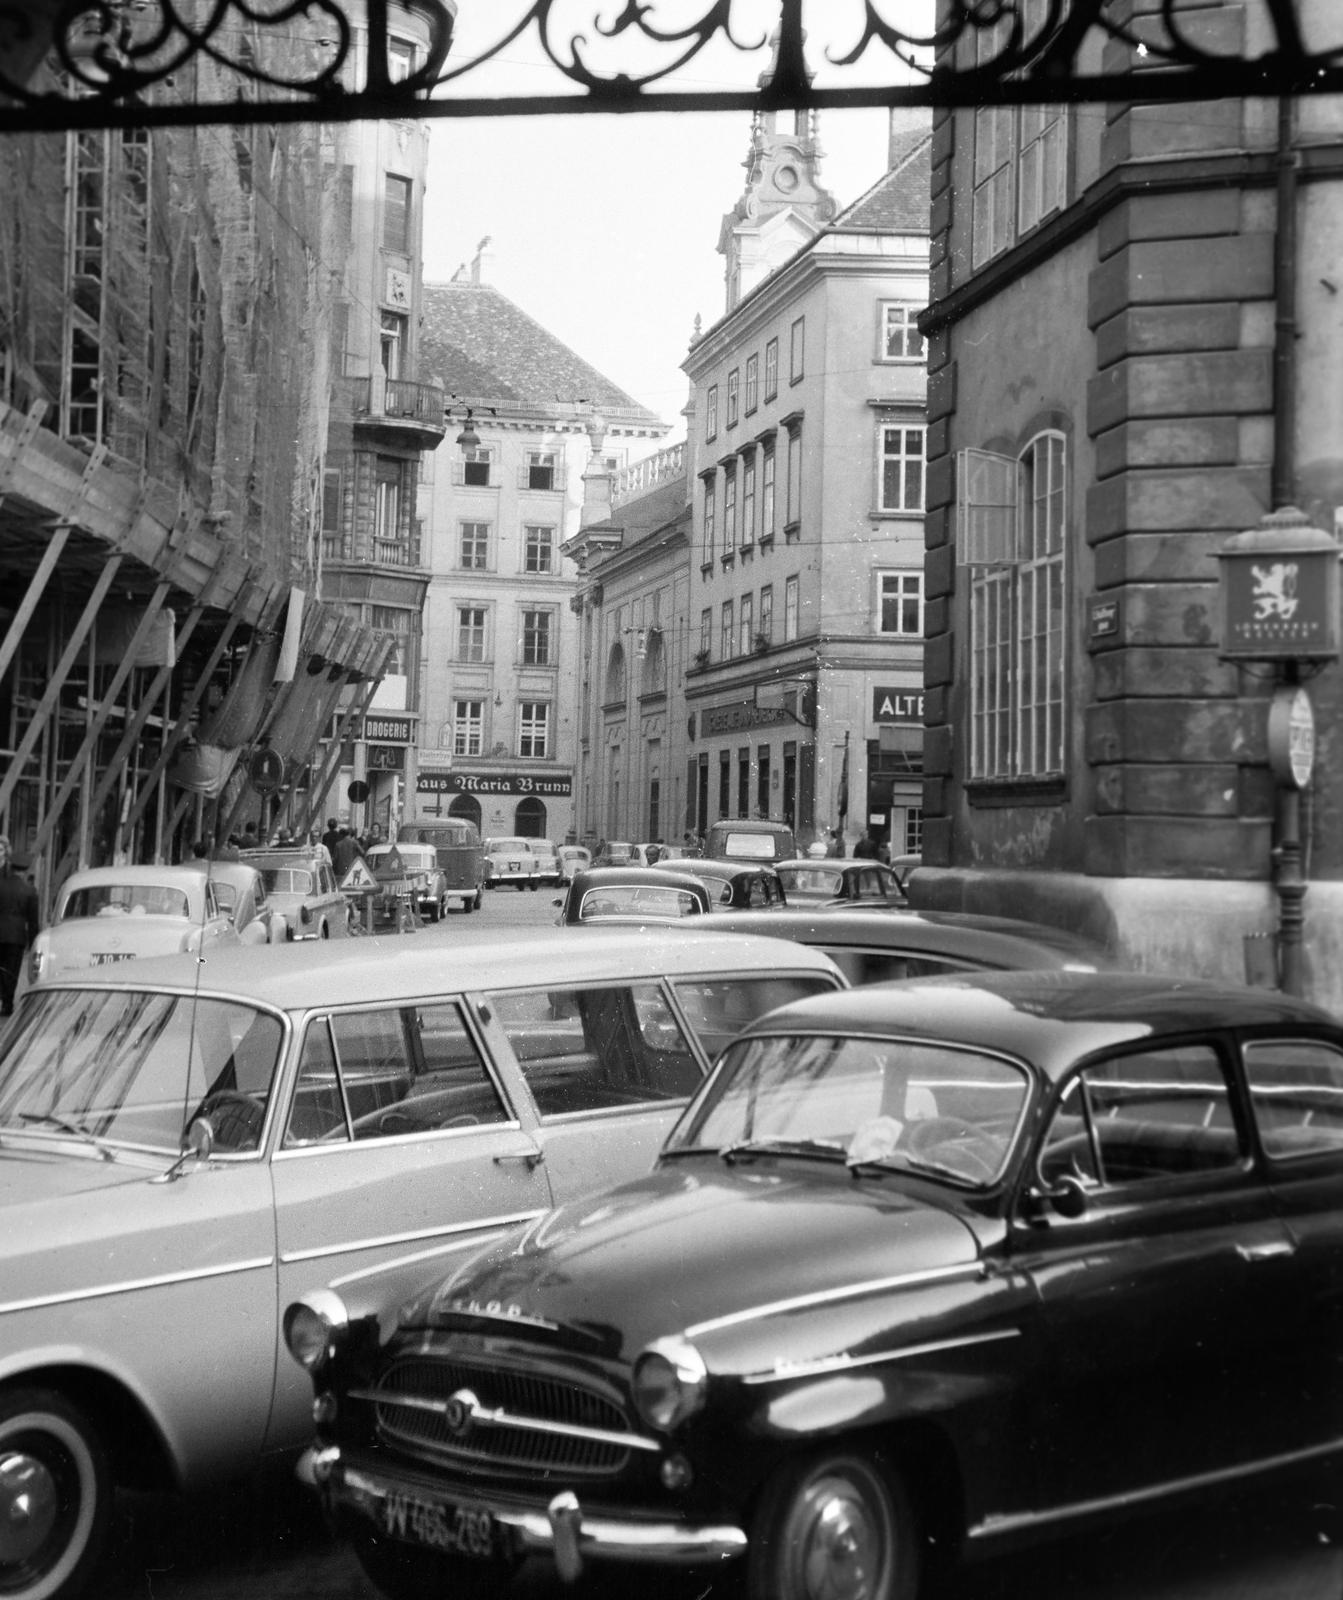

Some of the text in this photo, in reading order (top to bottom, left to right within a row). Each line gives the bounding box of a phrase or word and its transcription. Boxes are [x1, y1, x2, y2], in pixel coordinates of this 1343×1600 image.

[879, 695, 924, 716] ALTE
[367, 721, 408, 738] DROGERIE
[416, 775, 570, 793] aus Maria Brunn
[385, 1494, 408, 1537] W
